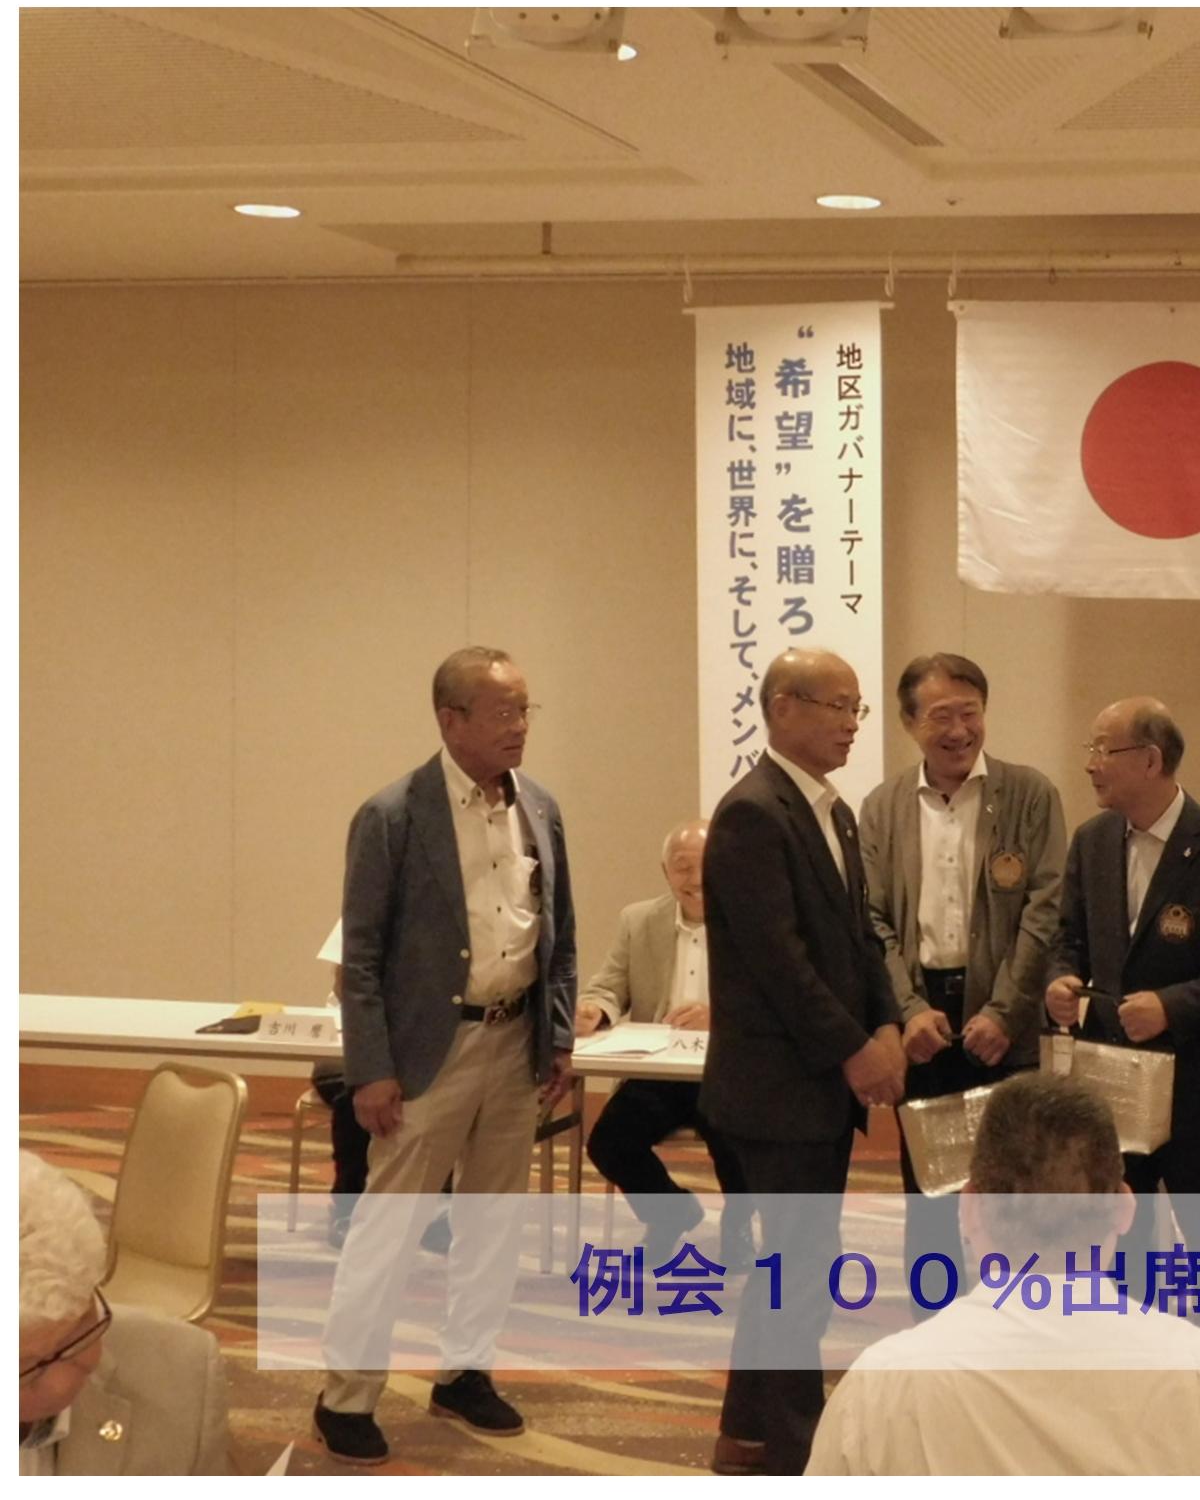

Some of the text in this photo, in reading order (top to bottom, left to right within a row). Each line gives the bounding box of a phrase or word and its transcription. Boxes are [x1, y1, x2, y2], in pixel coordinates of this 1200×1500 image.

[774, 326, 815, 652] “希望”を贈ろ
[836, 343, 864, 615] 地区ガバナーテーマ
